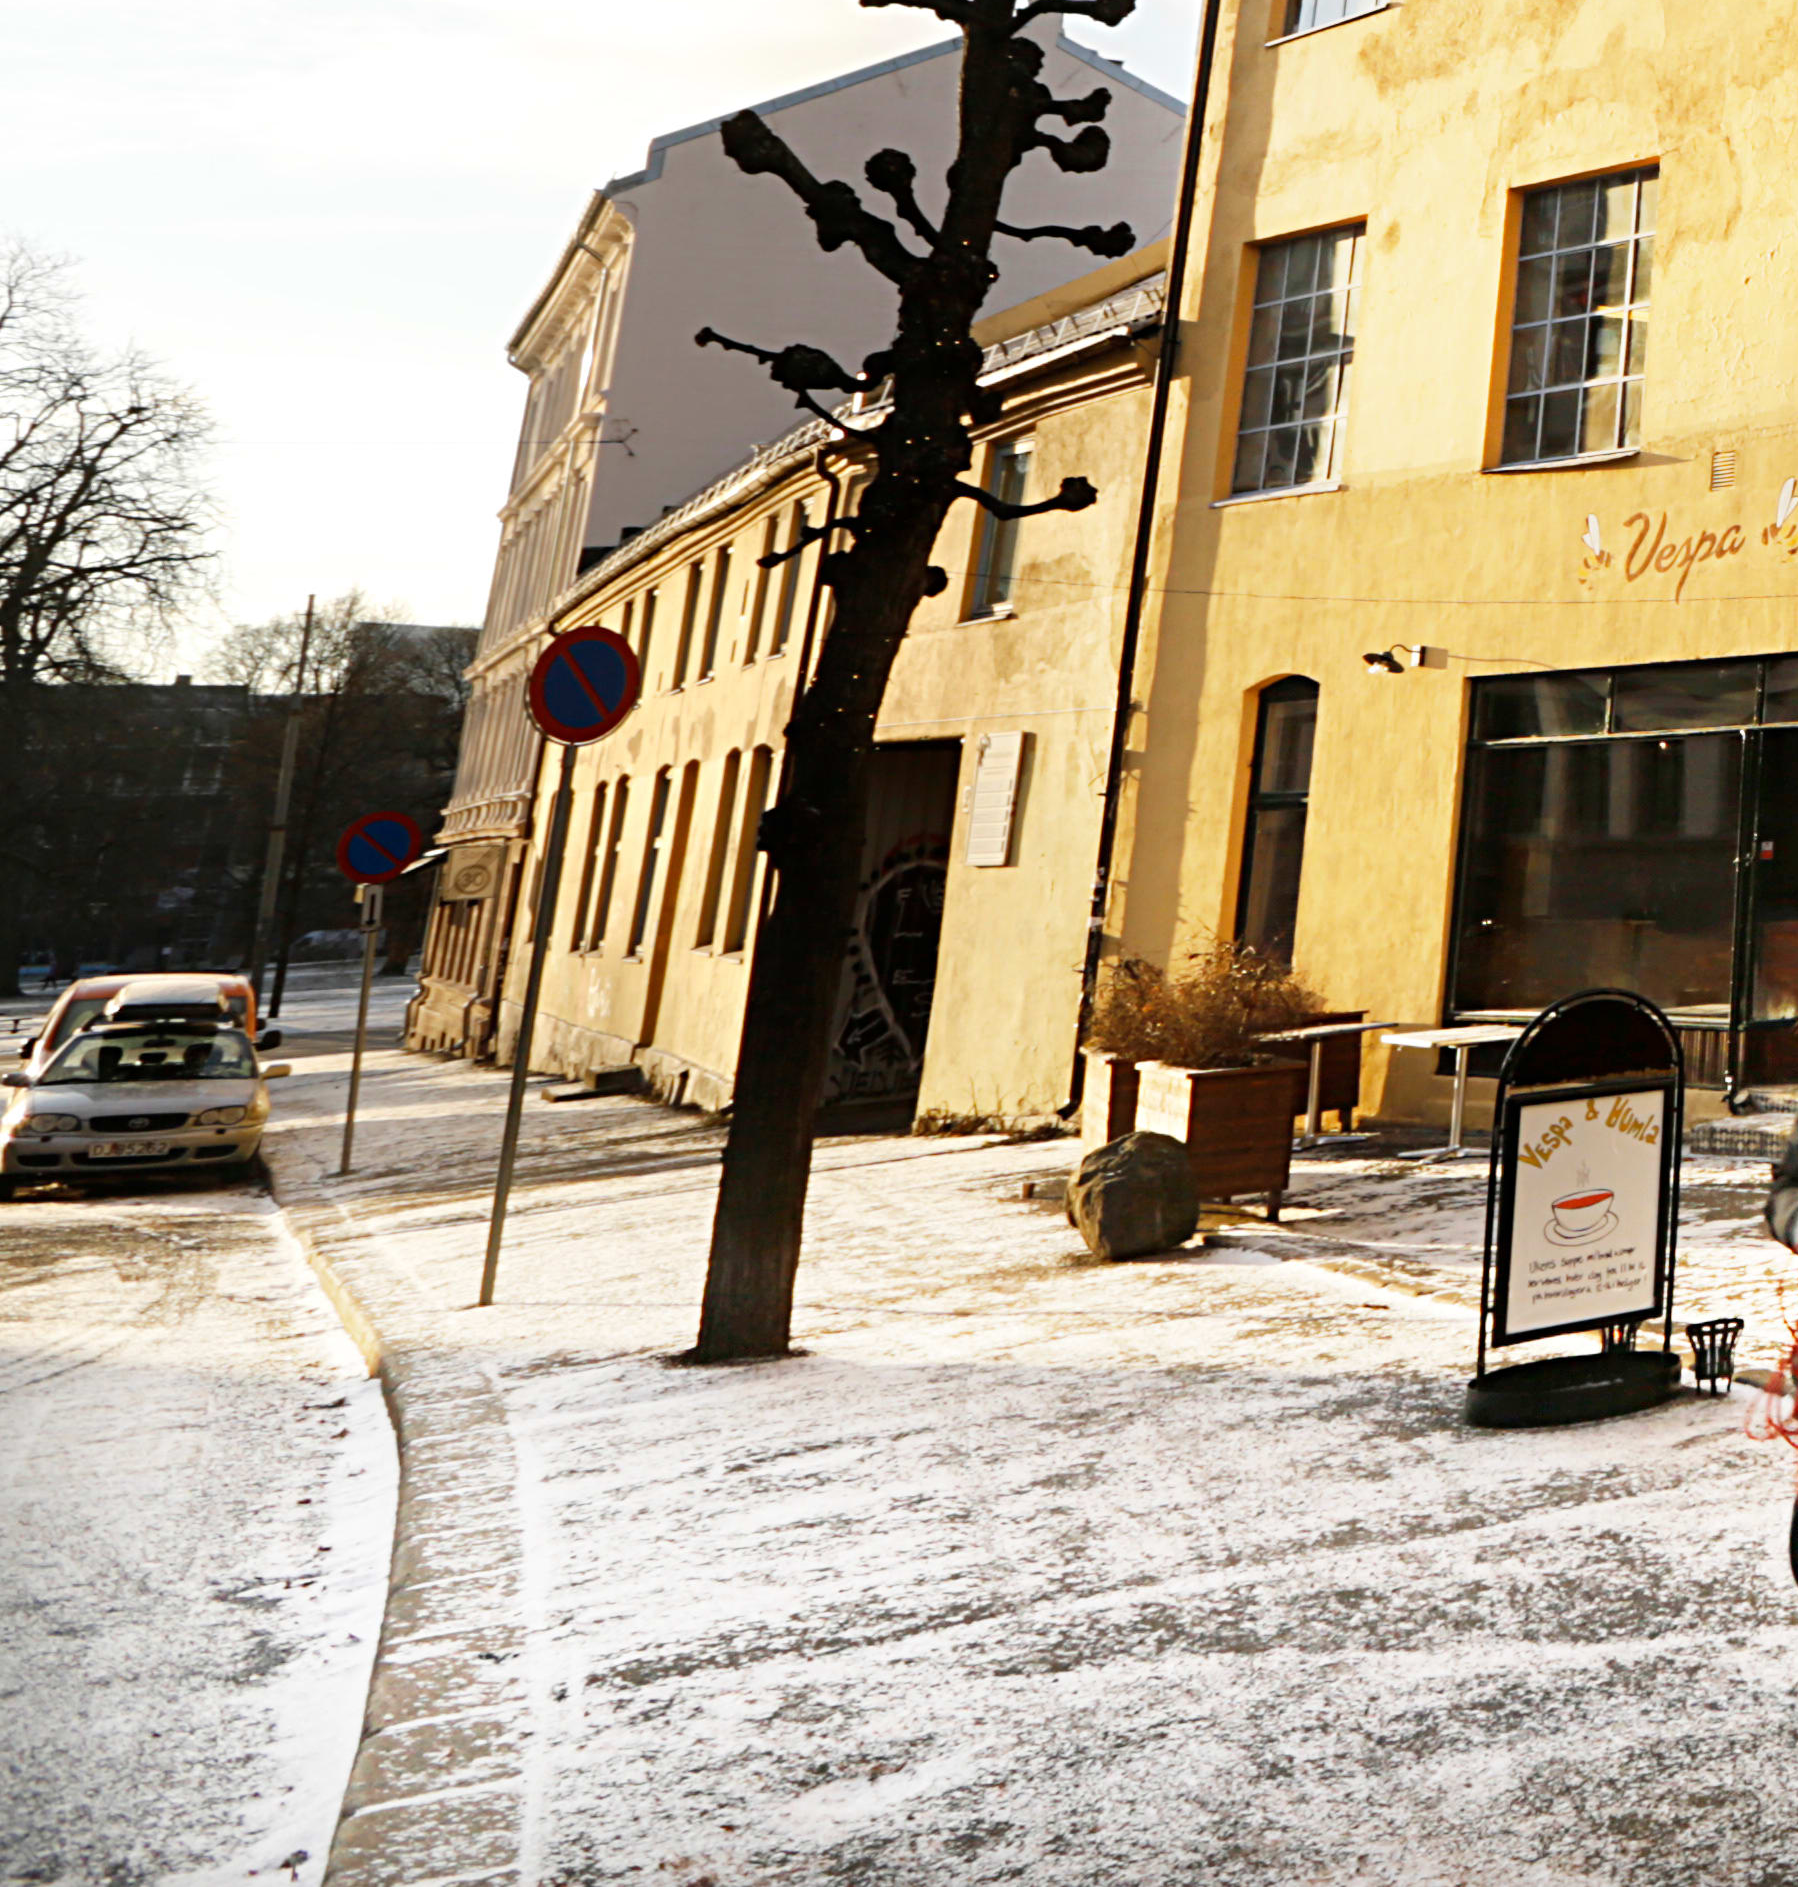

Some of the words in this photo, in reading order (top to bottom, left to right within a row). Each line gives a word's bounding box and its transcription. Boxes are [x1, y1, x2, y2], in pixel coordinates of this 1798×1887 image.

[1622, 510, 1746, 604] Vespa
[1585, 1098, 1599, 1121] &
[1605, 1096, 1660, 1145] Humla
